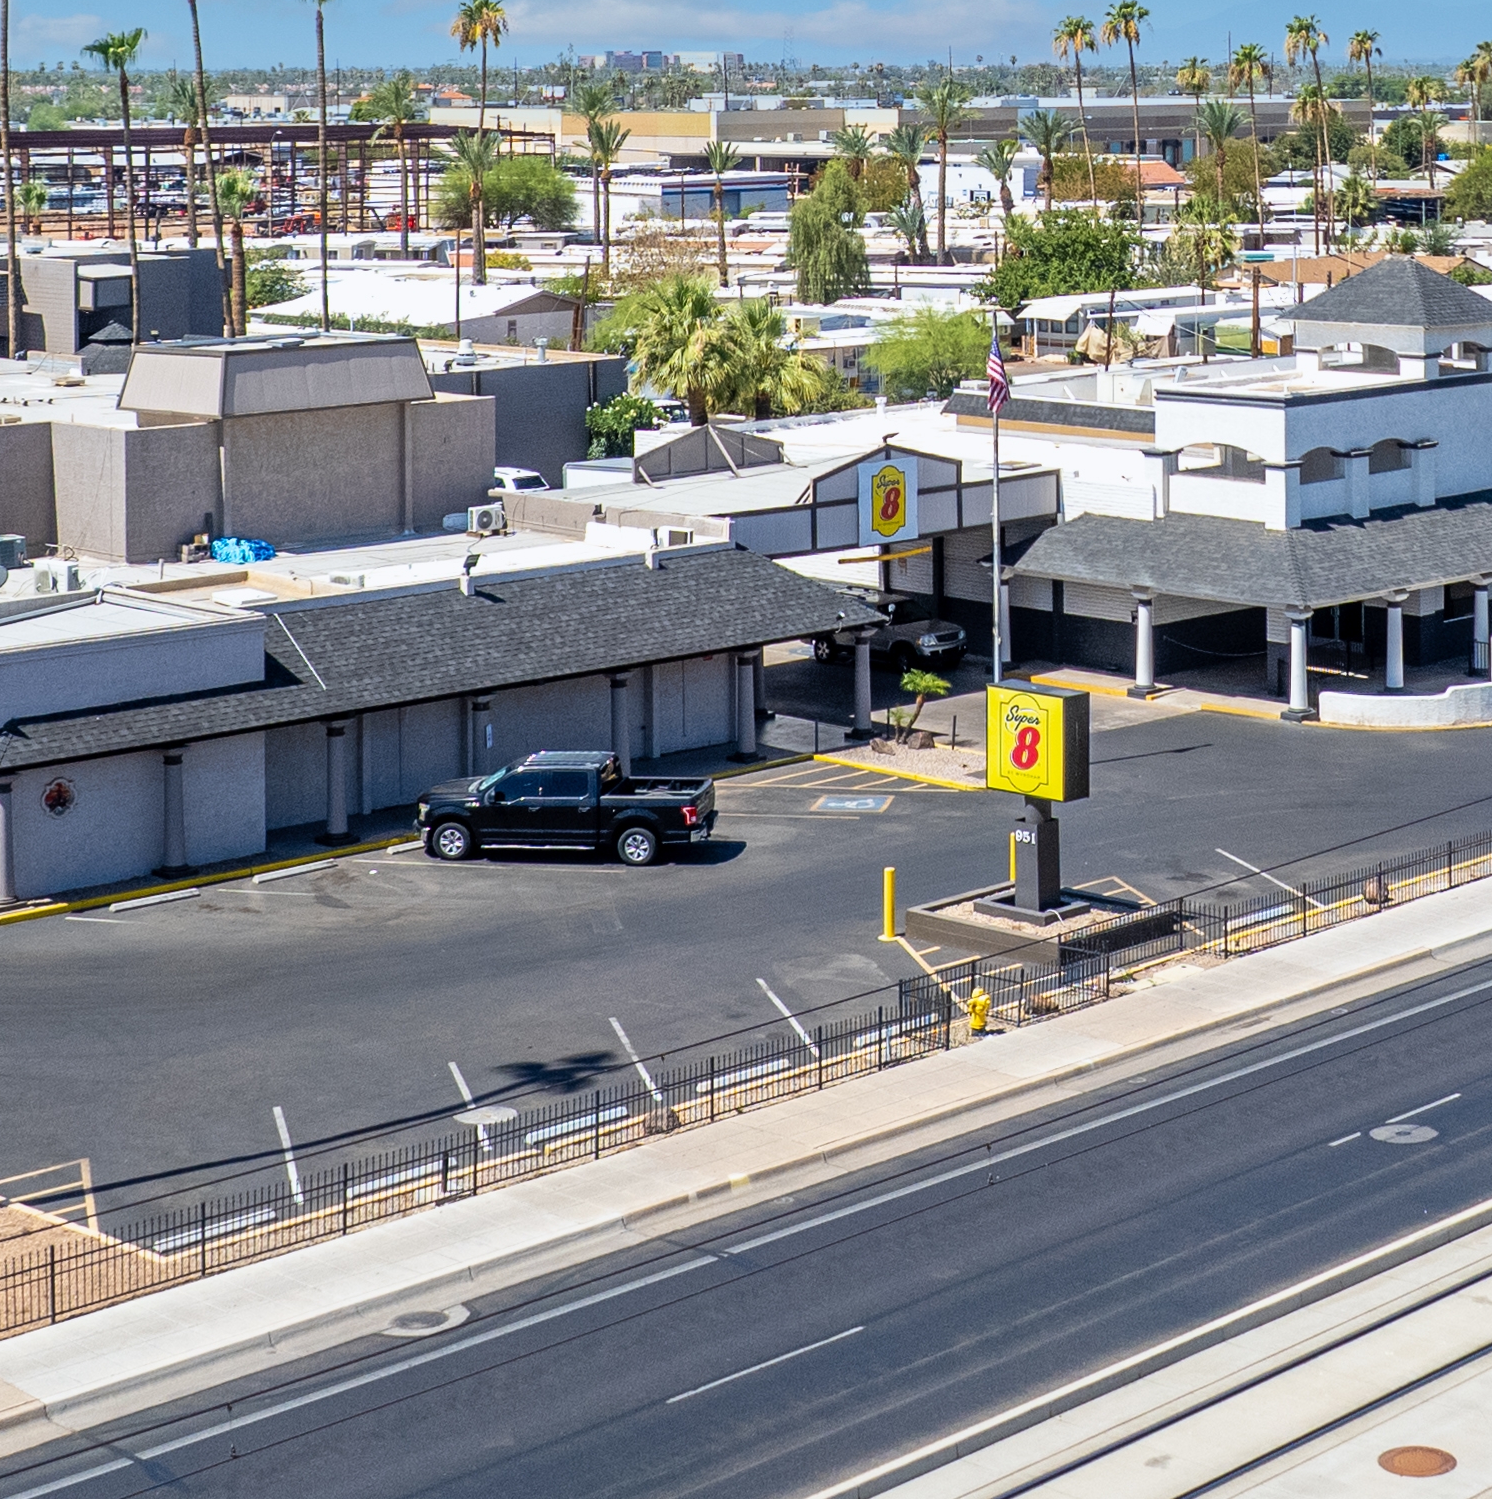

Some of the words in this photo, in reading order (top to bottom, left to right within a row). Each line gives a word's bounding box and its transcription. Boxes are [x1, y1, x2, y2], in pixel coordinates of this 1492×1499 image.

[880, 487, 901, 521] 8
[1006, 705, 1040, 731] Super
[1010, 726, 1040, 770] 8
[1015, 829, 1036, 846] 951
